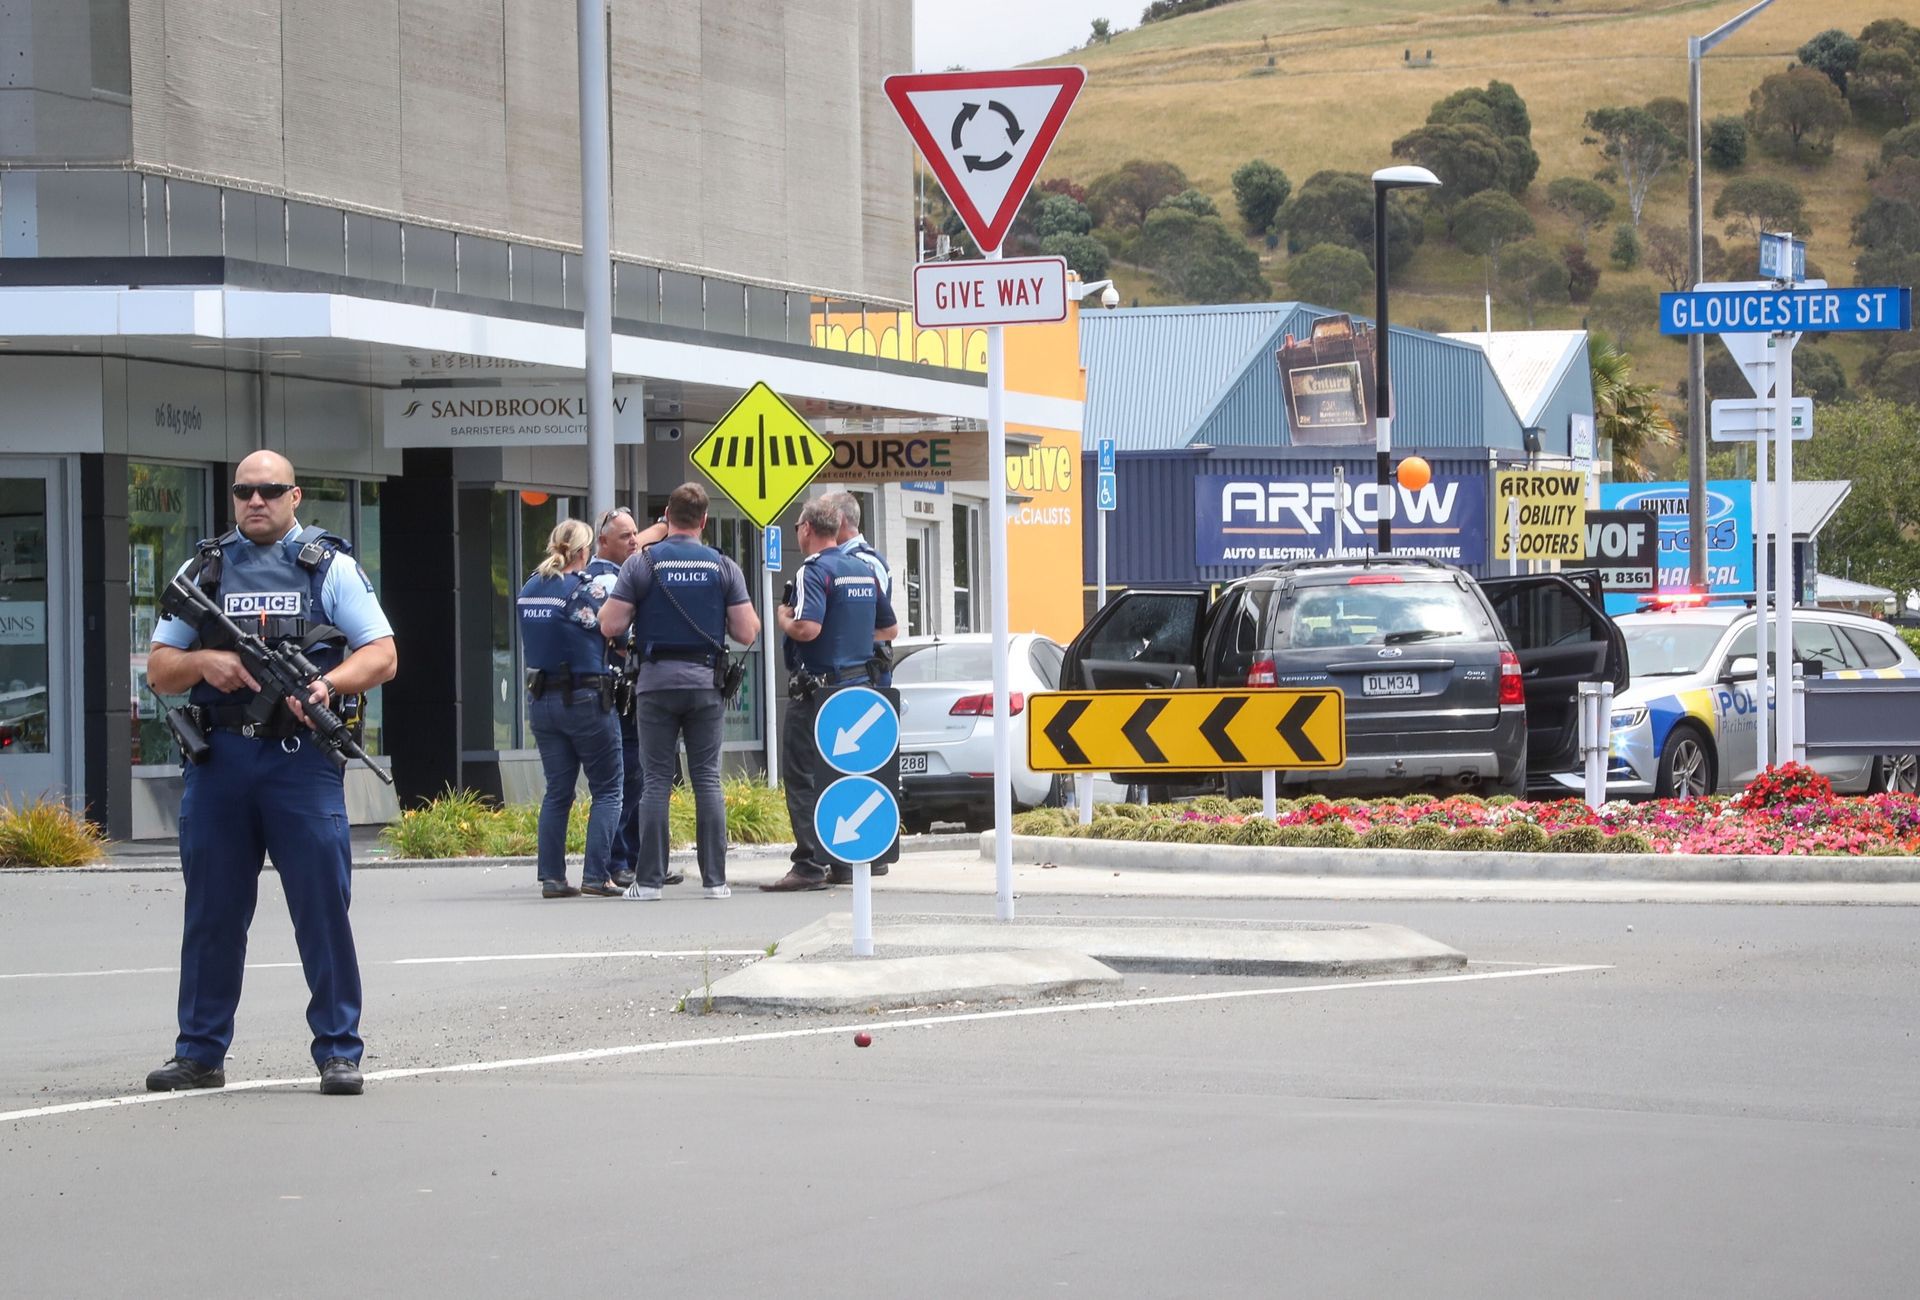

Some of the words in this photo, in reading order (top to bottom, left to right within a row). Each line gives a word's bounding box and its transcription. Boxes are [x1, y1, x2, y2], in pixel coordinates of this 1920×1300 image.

[935, 281, 985, 310] GIVE
[997, 277, 1044, 306] WAY
[1672, 295, 1840, 328] GLOUCESTER
[1855, 293, 1887, 323] ST
[431, 398, 575, 419] SANDBROOK
[578, 397, 628, 417] LW
[155, 403, 166, 427] 06
[167, 404, 181, 434] 845
[182, 405, 202, 434] 9060
[450, 426, 515, 436] BARRISTERS
[518, 425, 541, 434] AND
[1500, 477, 1579, 497] ARROW
[1222, 482, 1459, 535] ARROW
[1640, 498, 1689, 515] HUXTA
[770, 530, 776, 544] P
[1501, 534, 1579, 554] SOOTERS
[1223, 547, 1256, 560] AUTO
[1258, 547, 1316, 560] ELECTRIX
[1326, 547, 1375, 558] AARMS
[1391, 547, 1460, 559] UTOMOTIVE
[667, 572, 708, 582] POLICE
[1616, 572, 1650, 585] 8361
[848, 588, 873, 597] POLICE
[229, 596, 296, 612] POLICE
[523, 608, 552, 618] POLICE
[1369, 676, 1413, 690] DLM34
[901, 758, 925, 770] 288
